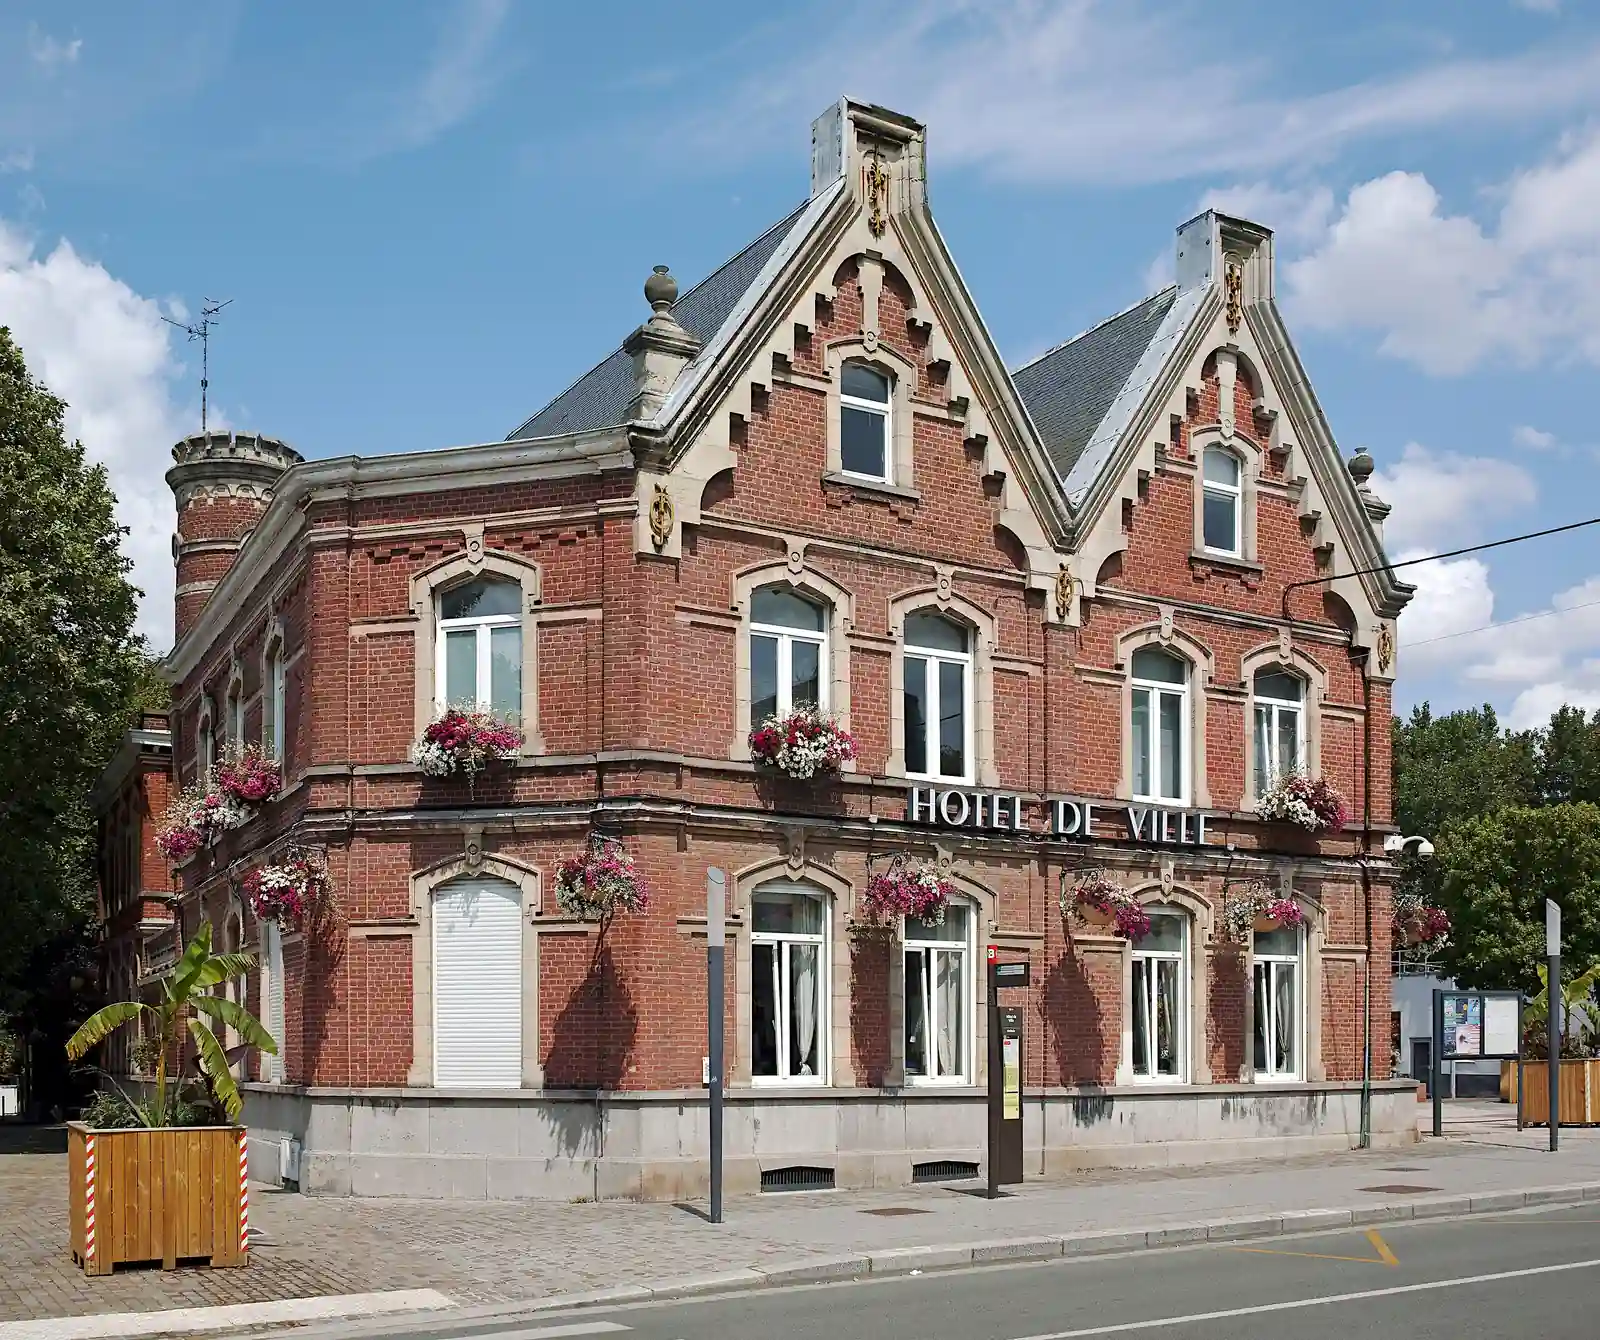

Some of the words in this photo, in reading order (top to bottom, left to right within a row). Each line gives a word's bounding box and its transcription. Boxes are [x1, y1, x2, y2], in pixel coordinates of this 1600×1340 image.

[911, 787, 1030, 830] HOTEL
[1057, 800, 1101, 837] DE
[1127, 807, 1214, 846] VILLE
